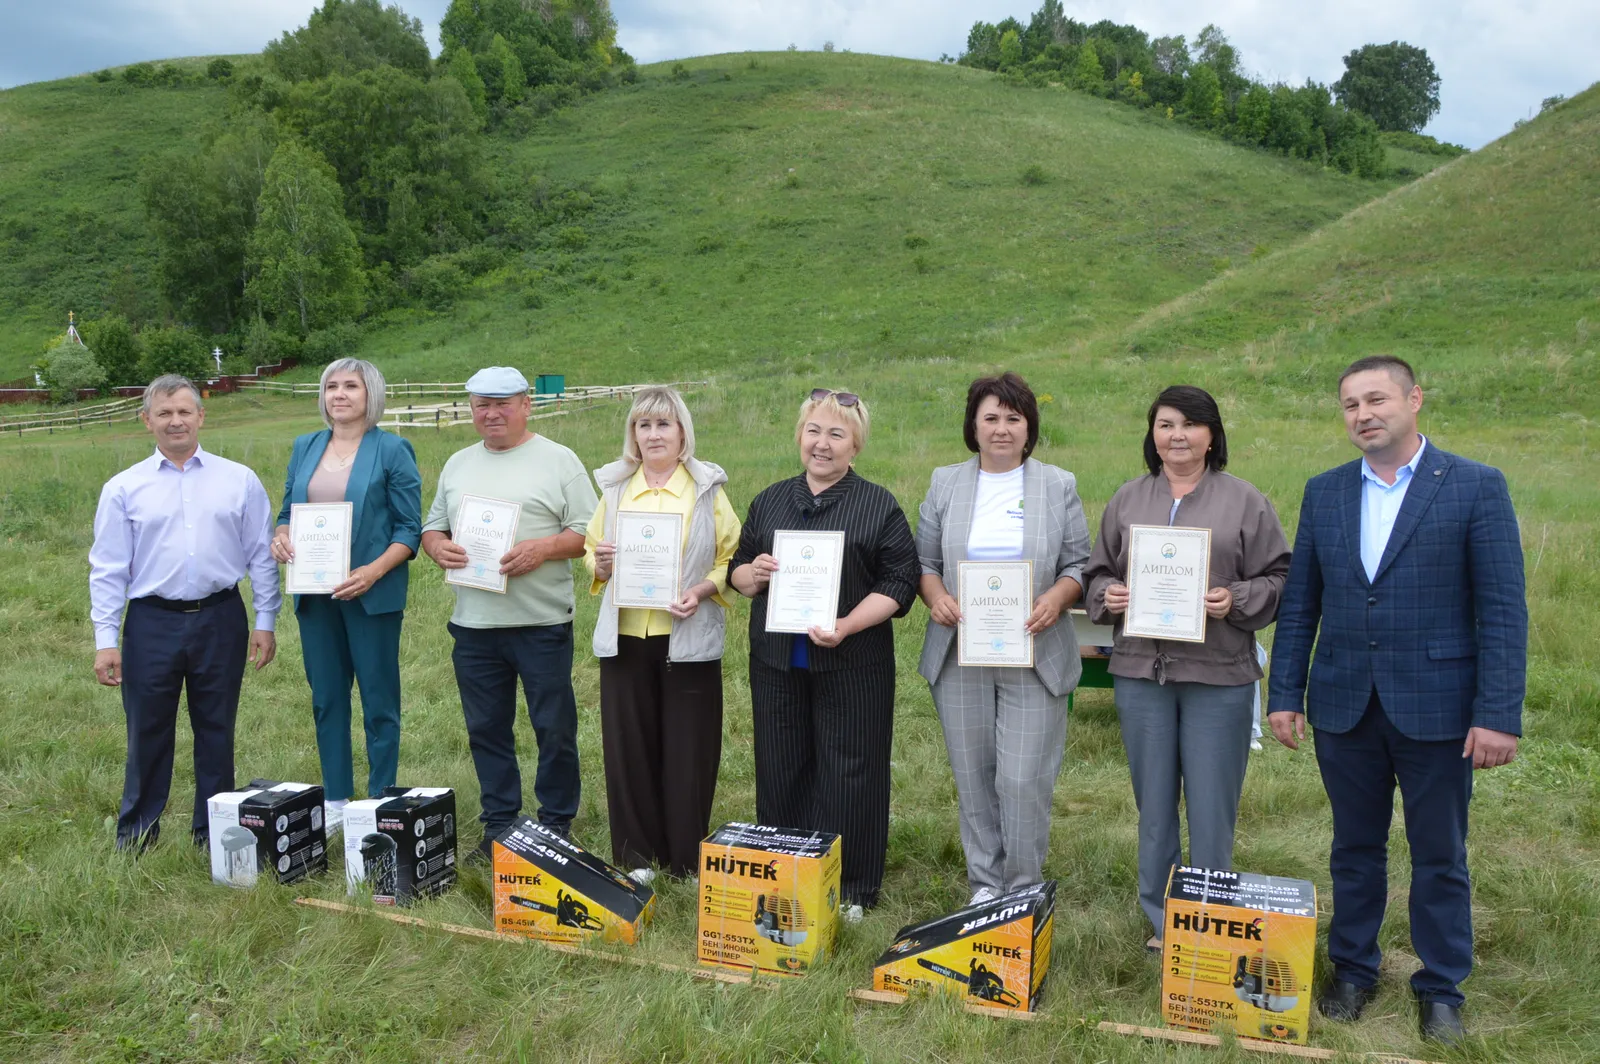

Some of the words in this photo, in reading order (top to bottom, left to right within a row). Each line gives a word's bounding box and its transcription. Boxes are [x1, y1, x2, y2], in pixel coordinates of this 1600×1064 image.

[299, 533, 340, 542] ДИПЛОМ
[464, 525, 504, 540] ДИПЛОМ
[624, 544, 670, 554] ДИПЛОМ
[784, 565, 828, 575] ДИПЛОМ
[1141, 564, 1194, 577] ДИПЛОМ
[970, 597, 1019, 607] ДИПЛОМ
[524, 819, 580, 854] HÜTER
[511, 830, 569, 865] BS-45M
[705, 854, 778, 881] HÜTER
[499, 872, 541, 886] HÜTER
[501, 917, 535, 926] BS-45M
[963, 903, 1028, 930] HÜTER
[1173, 911, 1262, 941] HÜTER
[703, 930, 755, 946] GGT-553TX
[702, 948, 741, 961] ТРИММЕР
[972, 941, 1022, 960] HÜTER
[1169, 992, 1234, 1011] GGT-553TX
[1168, 1003, 1238, 1022] БЕНЗИНОВЫЙ
